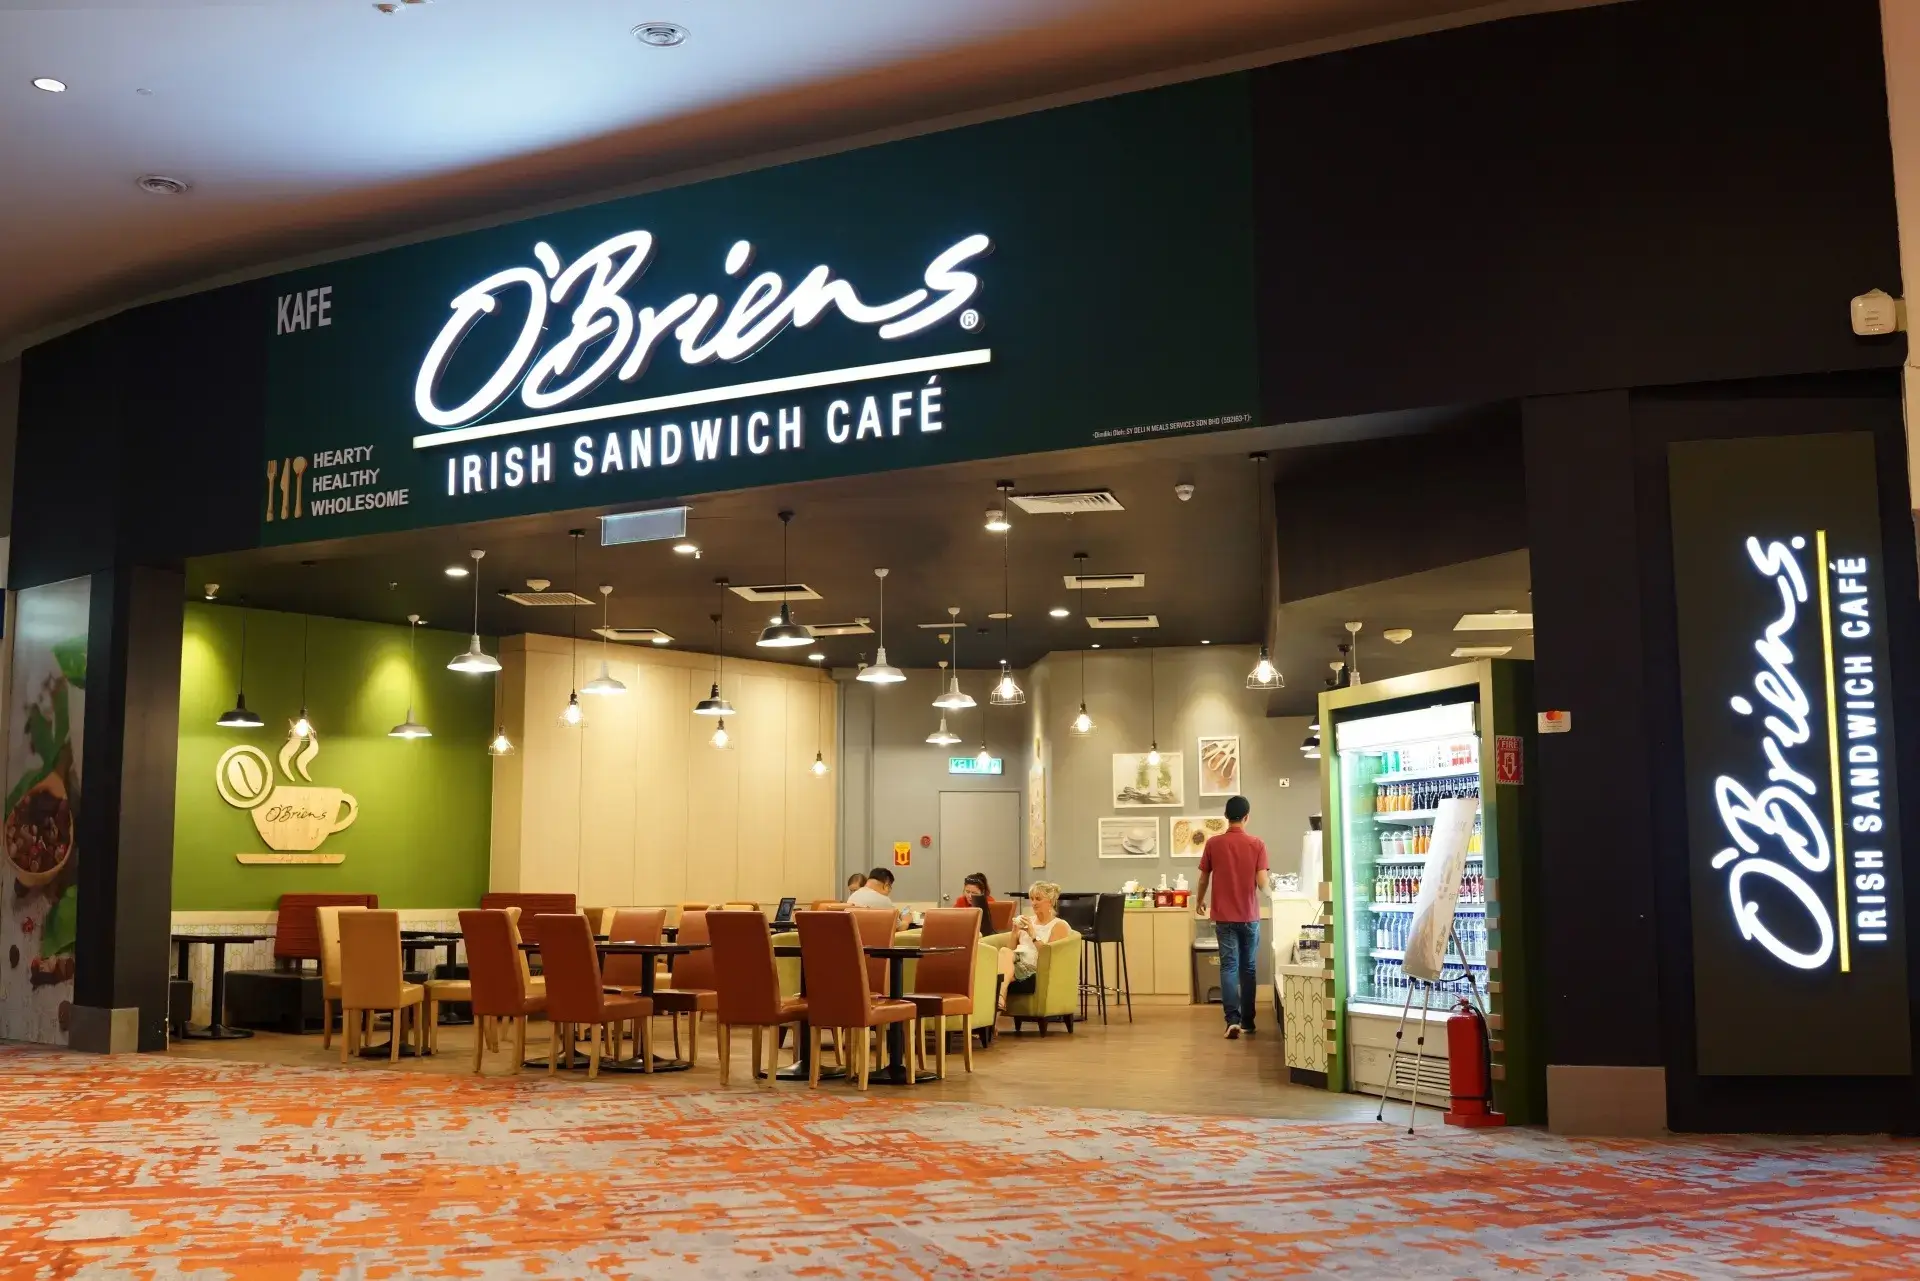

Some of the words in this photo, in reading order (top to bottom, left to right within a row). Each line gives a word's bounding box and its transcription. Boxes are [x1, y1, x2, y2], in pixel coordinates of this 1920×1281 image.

[277, 285, 333, 336] KAFE
[448, 445, 551, 496] IRISH
[574, 405, 802, 477] SANDWICH
[826, 374, 944, 444] CAFÉ
[1133, 425, 1146, 434] DELI
[1151, 423, 1169, 432] MEALS
[1169, 420, 1195, 430] SERVICES
[1195, 418, 1208, 427] SDN
[1208, 417, 1220, 425] BHD
[313, 444, 374, 469] HEARTY
[312, 467, 380, 493] HEALTHY
[311, 488, 409, 517] WHOLESOME
[1829, 556, 1872, 639] CAFÉ
[1501, 740, 1519, 749] FIRE
[1843, 655, 1884, 834] SANDWICH
[265, 804, 328, 823] O'Briens
[1854, 849, 1888, 942] IRISH
